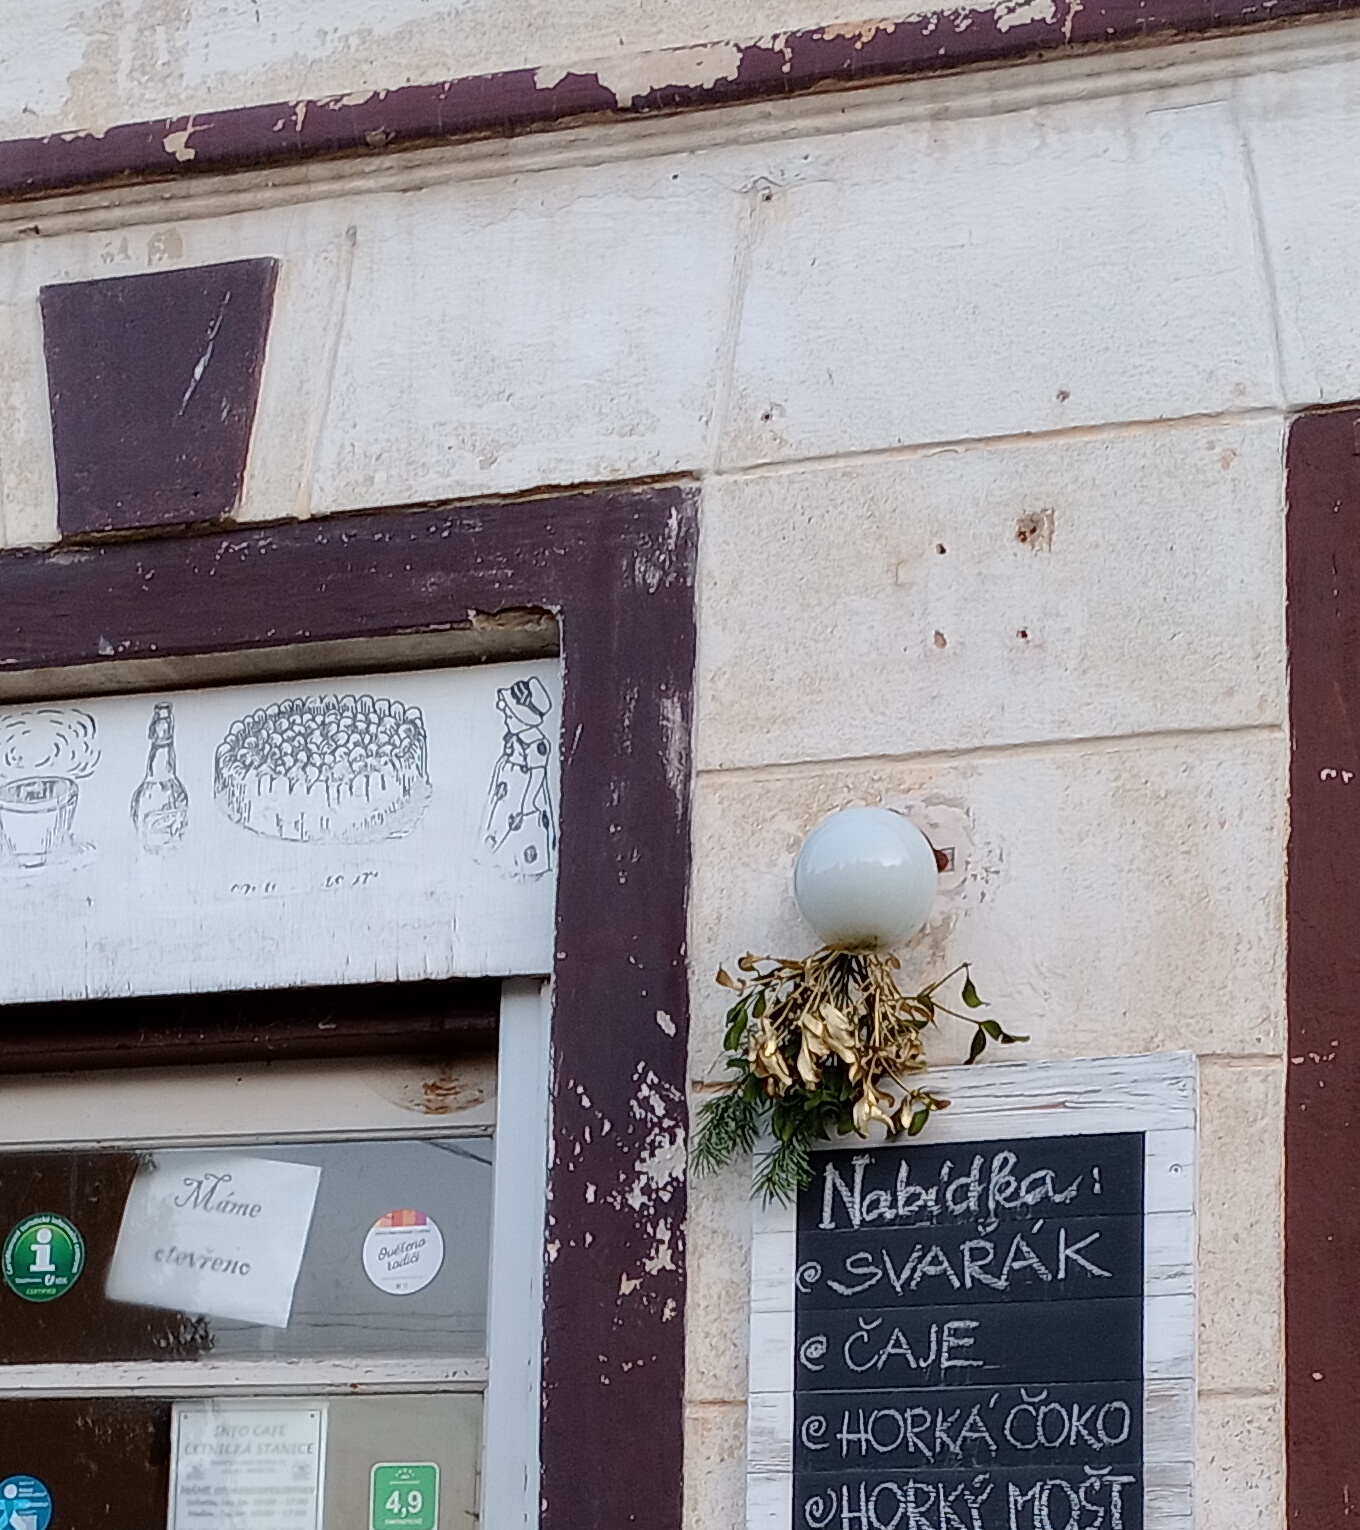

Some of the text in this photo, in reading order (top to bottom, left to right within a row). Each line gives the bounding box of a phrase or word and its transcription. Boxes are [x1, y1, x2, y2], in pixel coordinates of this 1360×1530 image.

[174, 1173, 262, 1218] Máme
[827, 1219, 1113, 1296] SVAŘÁK
[844, 1316, 983, 1373] ČAJE
[837, 1388, 1132, 1463] HORKÁ ČOKO
[385, 1490, 422, 1518] 4,9
